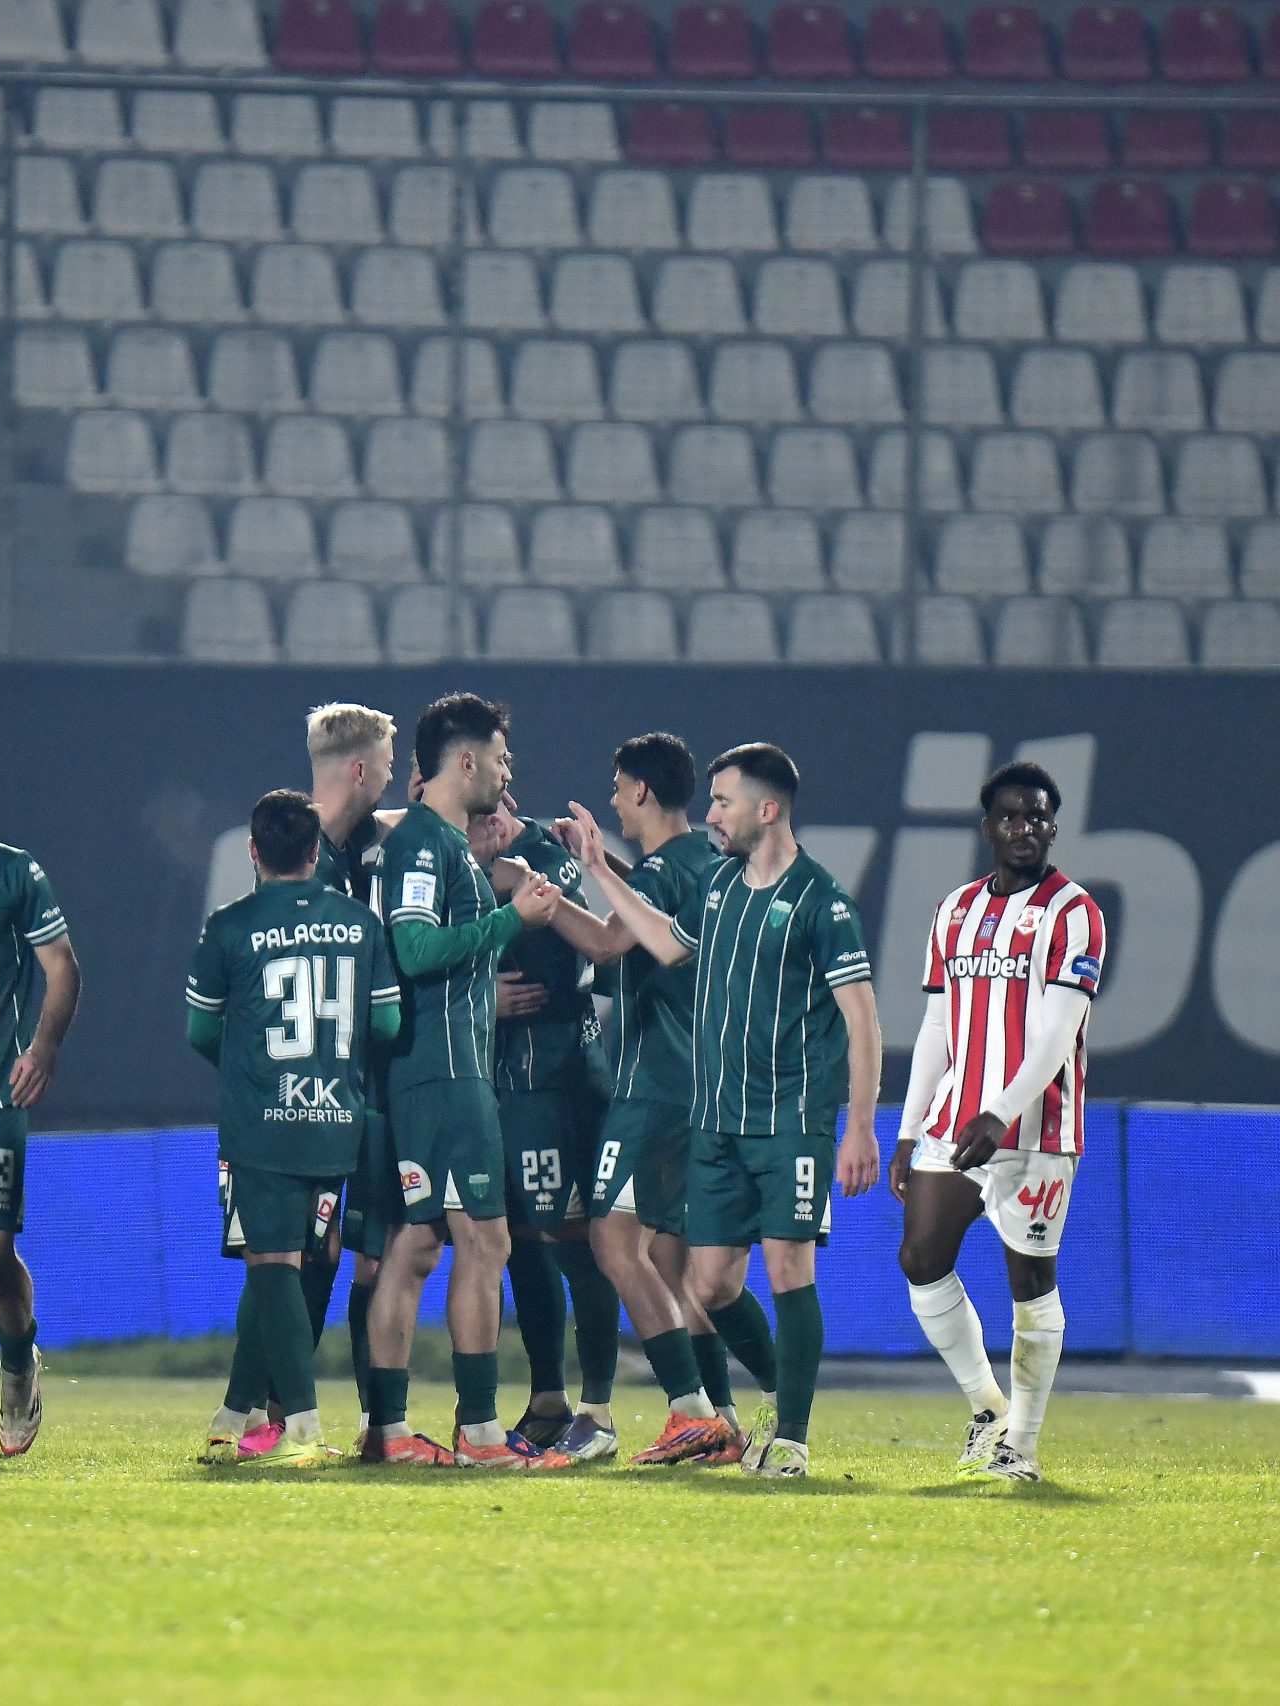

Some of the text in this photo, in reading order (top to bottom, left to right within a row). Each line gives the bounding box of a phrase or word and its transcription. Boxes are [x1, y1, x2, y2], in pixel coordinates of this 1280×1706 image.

[251, 923, 363, 952] PALACIOS
[262, 955, 355, 1060] 34
[263, 1108, 353, 1124] PROPERTIES
[521, 1148, 562, 1191] 23
[597, 1140, 622, 1180] 6
[795, 1156, 815, 1199] 9
[1017, 1178, 1065, 1221] 40
